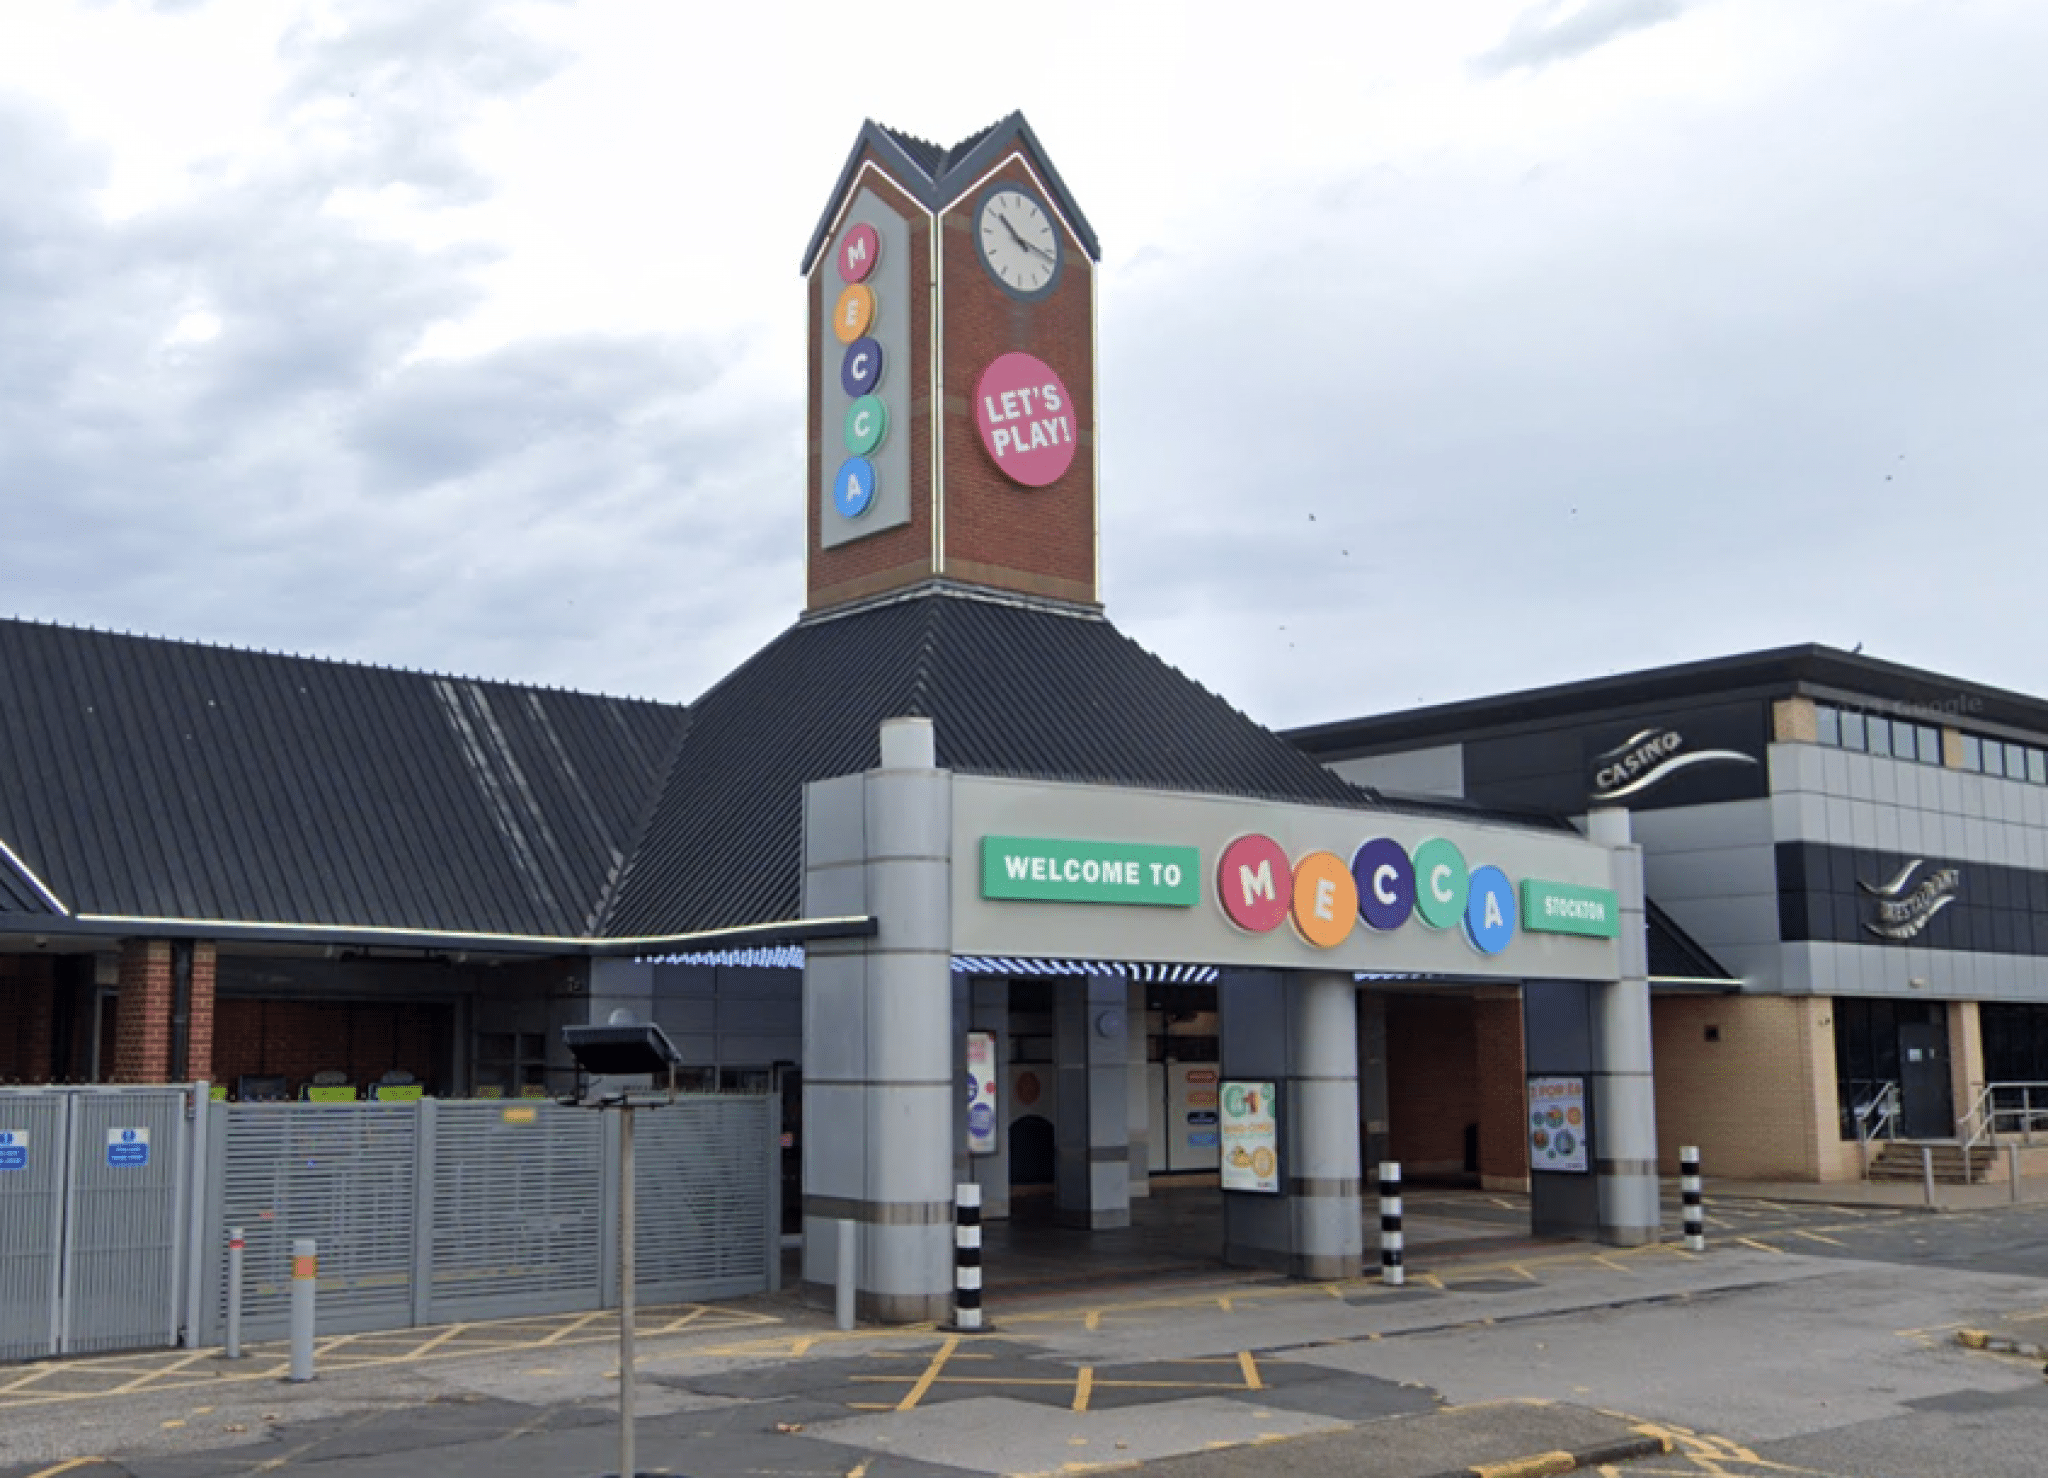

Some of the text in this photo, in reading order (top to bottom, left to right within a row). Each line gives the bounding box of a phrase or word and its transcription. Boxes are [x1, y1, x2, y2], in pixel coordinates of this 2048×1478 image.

[984, 384, 1063, 423] LET'S
[991, 416, 1073, 459] PLAY!
[1596, 731, 1683, 788] CASINO
[1003, 854, 1182, 887] WELCOME TO
[1236, 857, 1506, 932] MECCA
